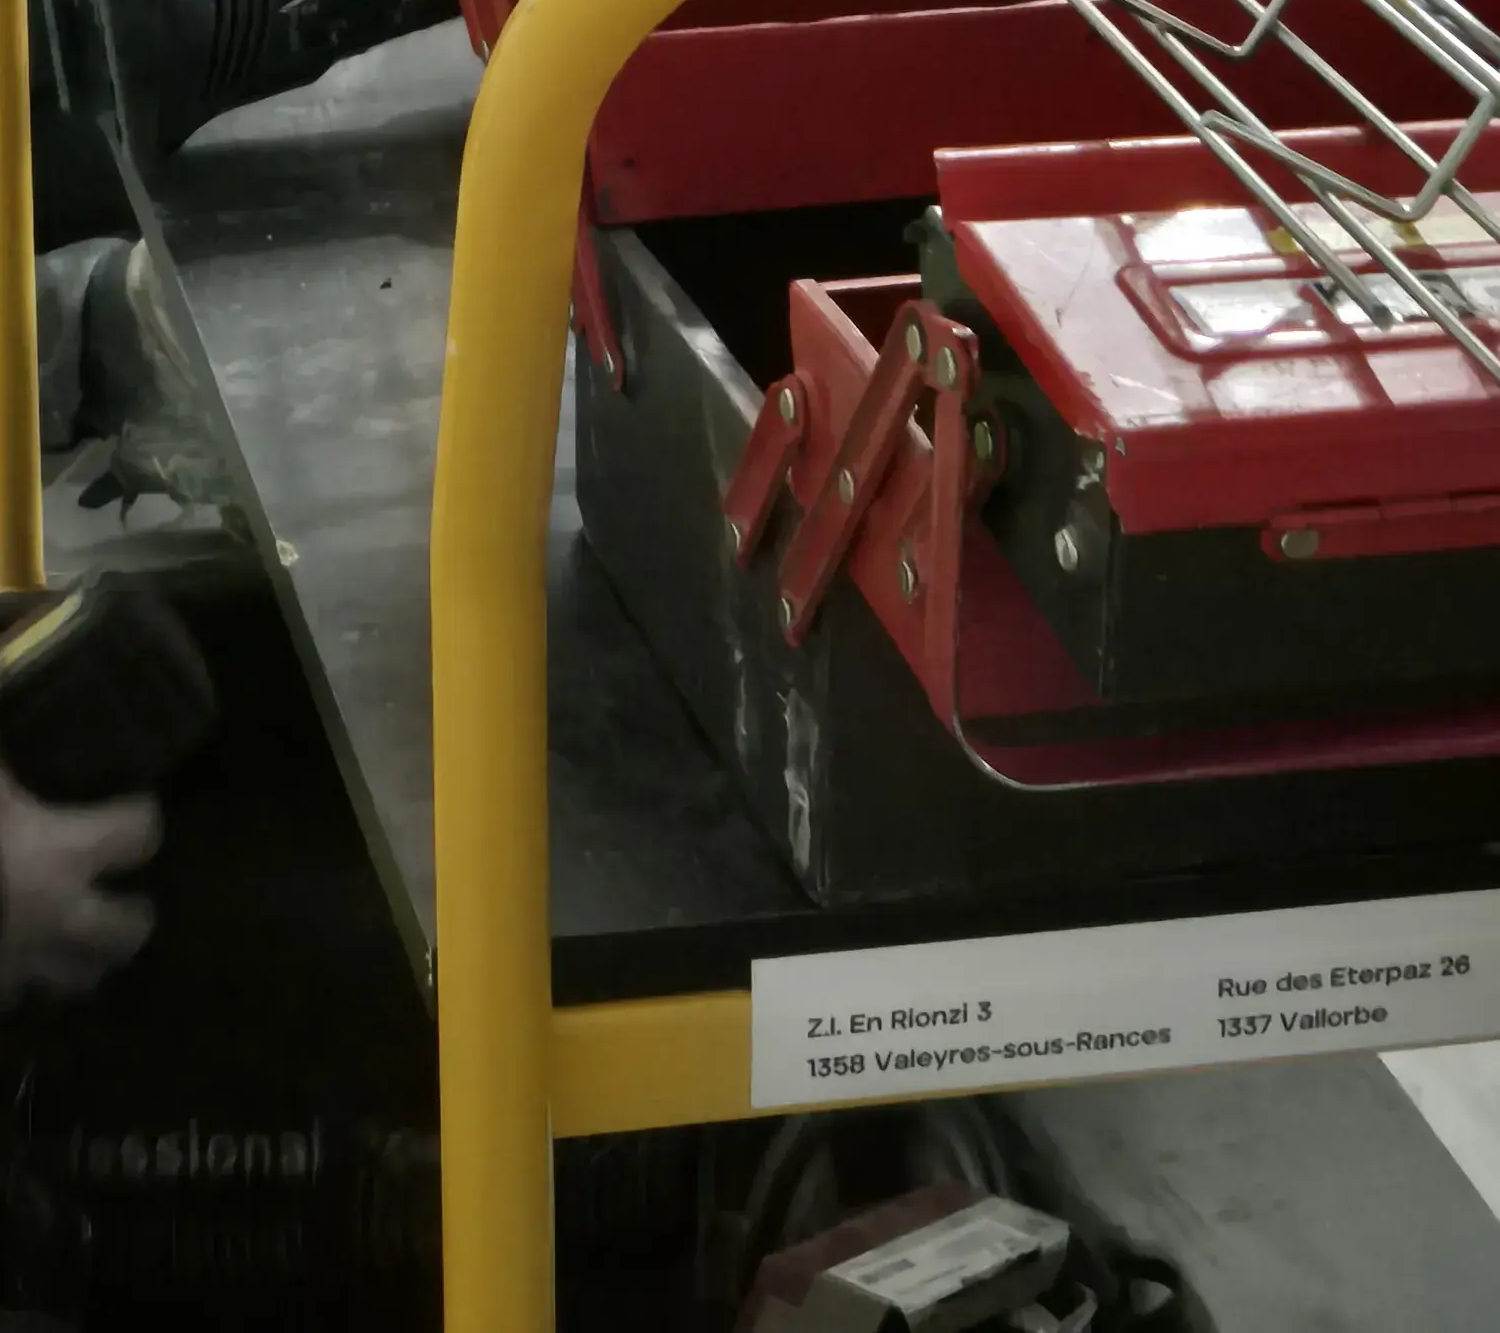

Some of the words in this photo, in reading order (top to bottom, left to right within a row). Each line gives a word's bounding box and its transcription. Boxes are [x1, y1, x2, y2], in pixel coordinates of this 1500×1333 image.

[1217, 977, 1267, 998] Rue
[1276, 971, 1323, 992] des
[1330, 961, 1433, 987] Eterpaz
[1440, 954, 1471, 977] 26
[849, 1013, 883, 1035] En
[891, 1001, 968, 1031] Rionzi
[977, 1000, 992, 1022] 3
[1217, 1013, 1272, 1038] 1337
[1280, 1004, 1389, 1032] Vallorbe
[806, 1054, 866, 1078] 1358
[874, 1026, 1172, 1072] Valeyres-sous-Rances
